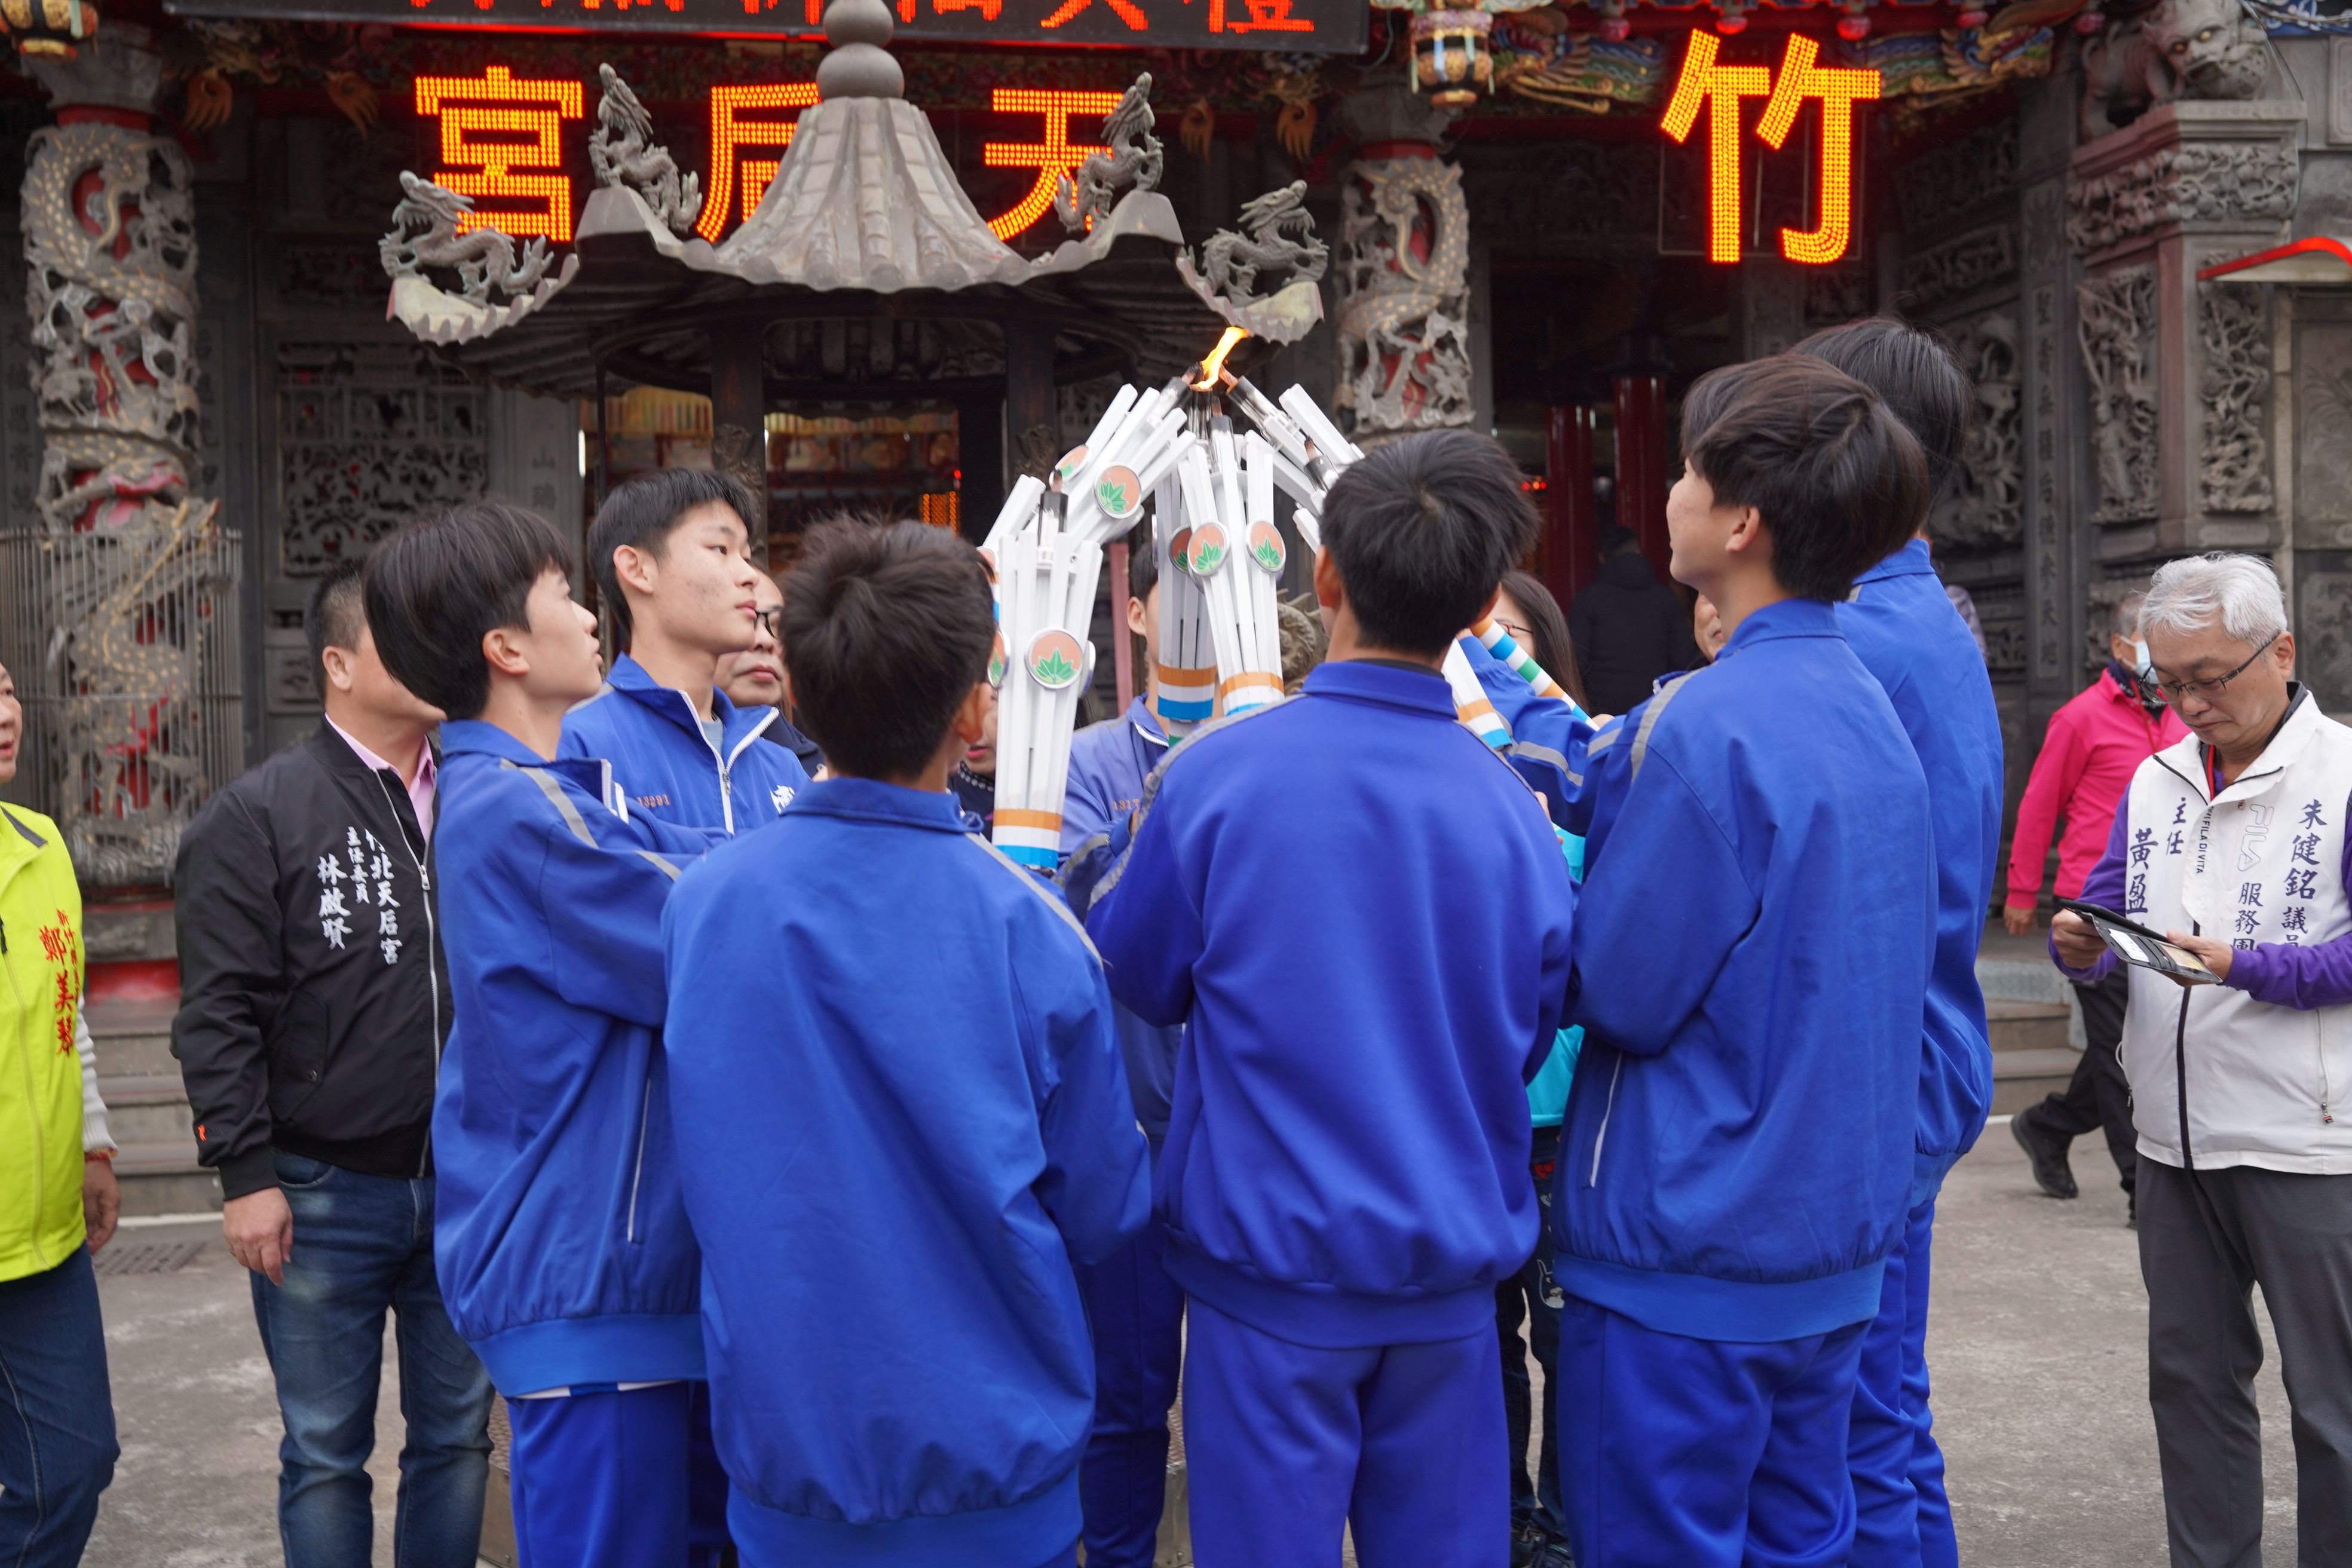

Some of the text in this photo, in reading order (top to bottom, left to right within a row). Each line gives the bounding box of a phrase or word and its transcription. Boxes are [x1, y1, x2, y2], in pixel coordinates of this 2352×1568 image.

[1661, 27, 1881, 264] 竹
[2166, 797, 2187, 856] 主任
[2200, 820, 2210, 841] FILA
[2196, 855, 2206, 874] VITA
[2199, 843, 2208, 852] DI
[2126, 827, 2159, 927] 黃盈
